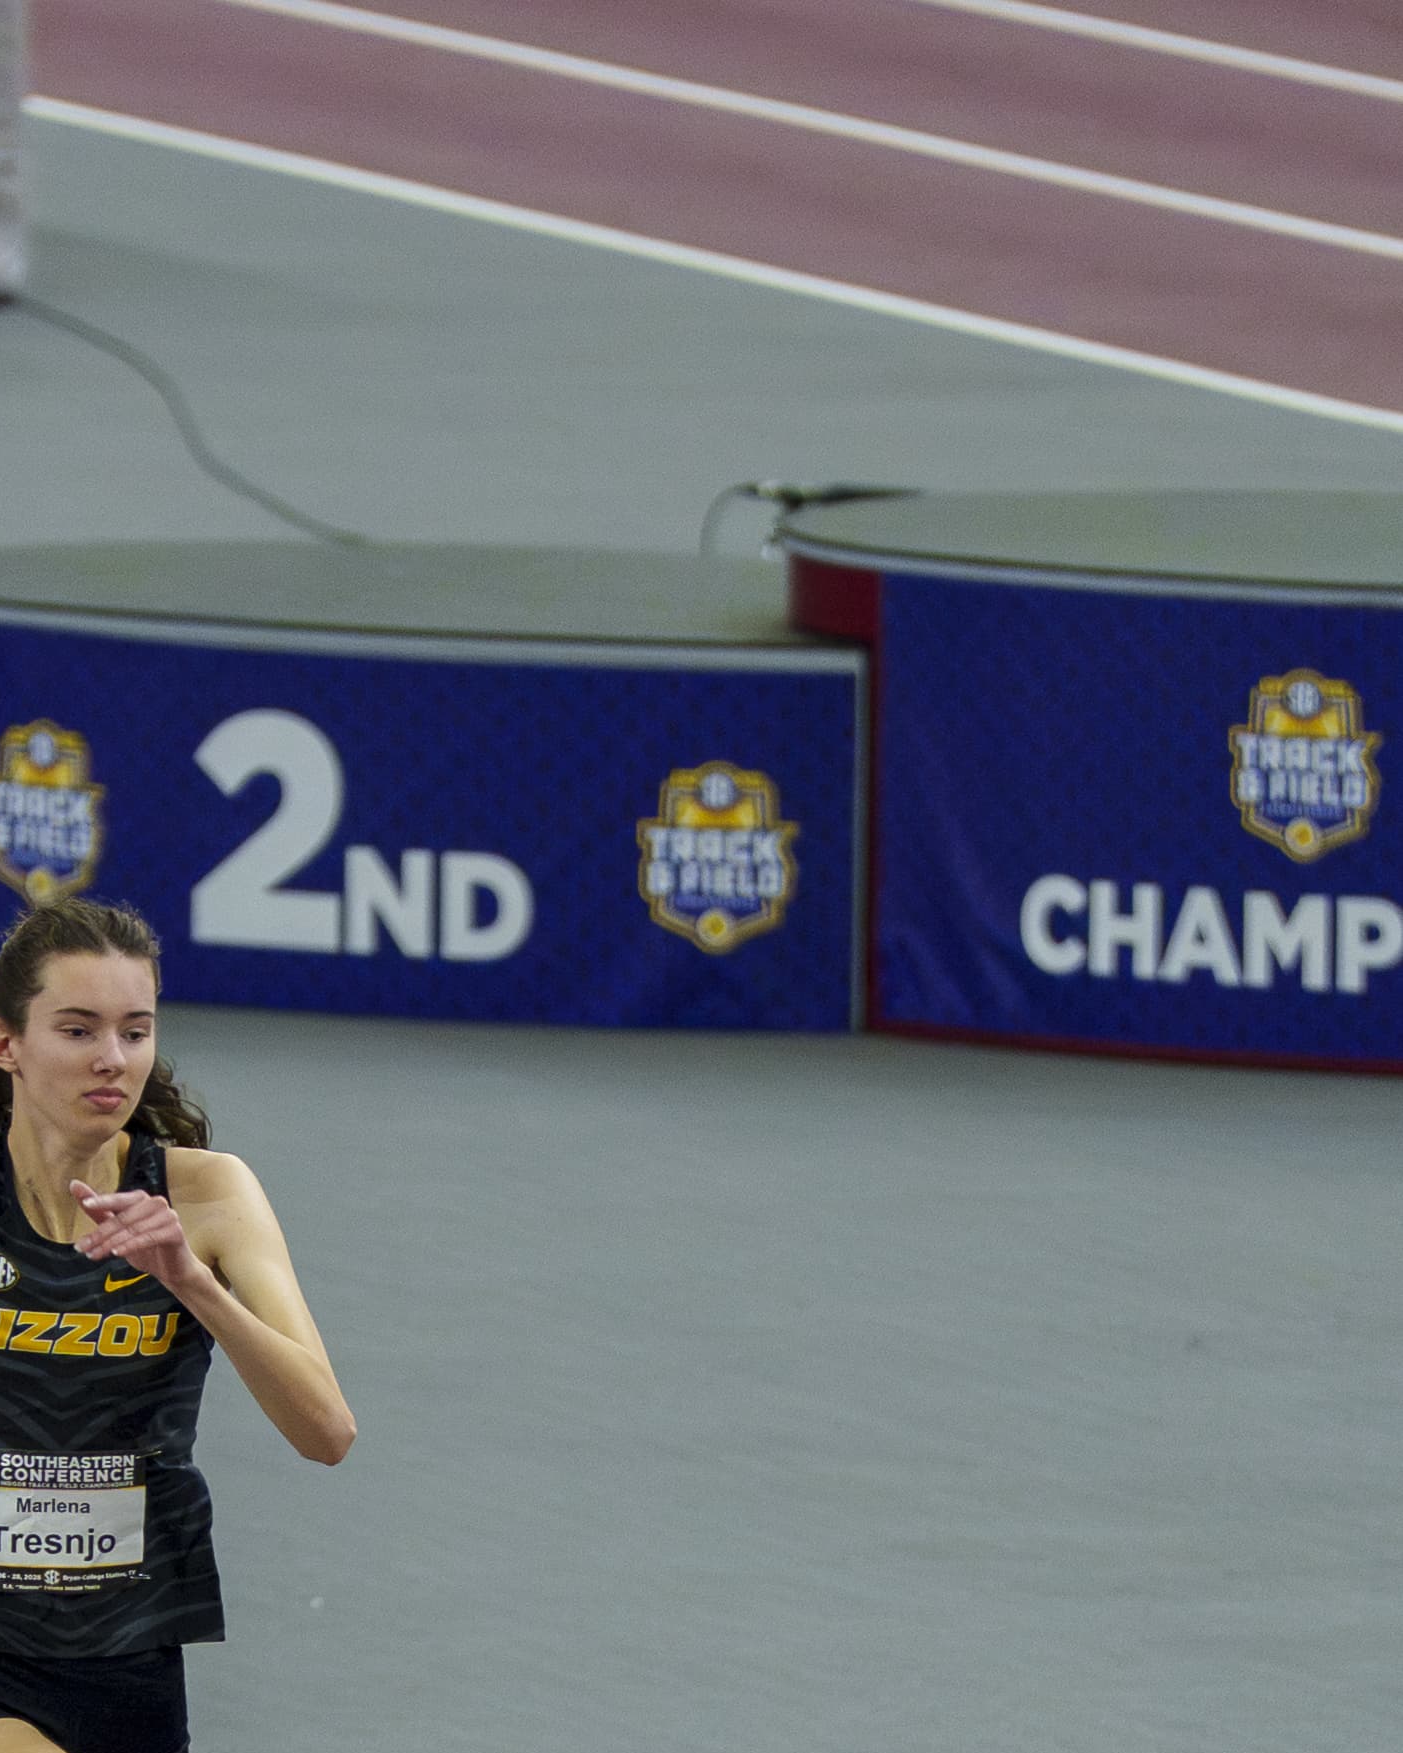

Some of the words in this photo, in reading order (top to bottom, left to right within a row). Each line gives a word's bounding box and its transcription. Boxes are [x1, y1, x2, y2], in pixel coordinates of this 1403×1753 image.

[1235, 734, 1369, 776] TRACK
[1268, 769, 1368, 808] FIELD
[191, 707, 535, 963] 2ND
[646, 826, 784, 864] TRACK
[678, 860, 785, 899] FIELD
[1019, 874, 1403, 994] CHAMP
[0, 1453, 135, 1469] SOUTHEASTERN
[0, 1467, 135, 1483] CONFERENCE
[28, 1481, 51, 1489] TRACK
[16, 1497, 90, 1514] Marlena
[44, 1569, 60, 1585] SEC
